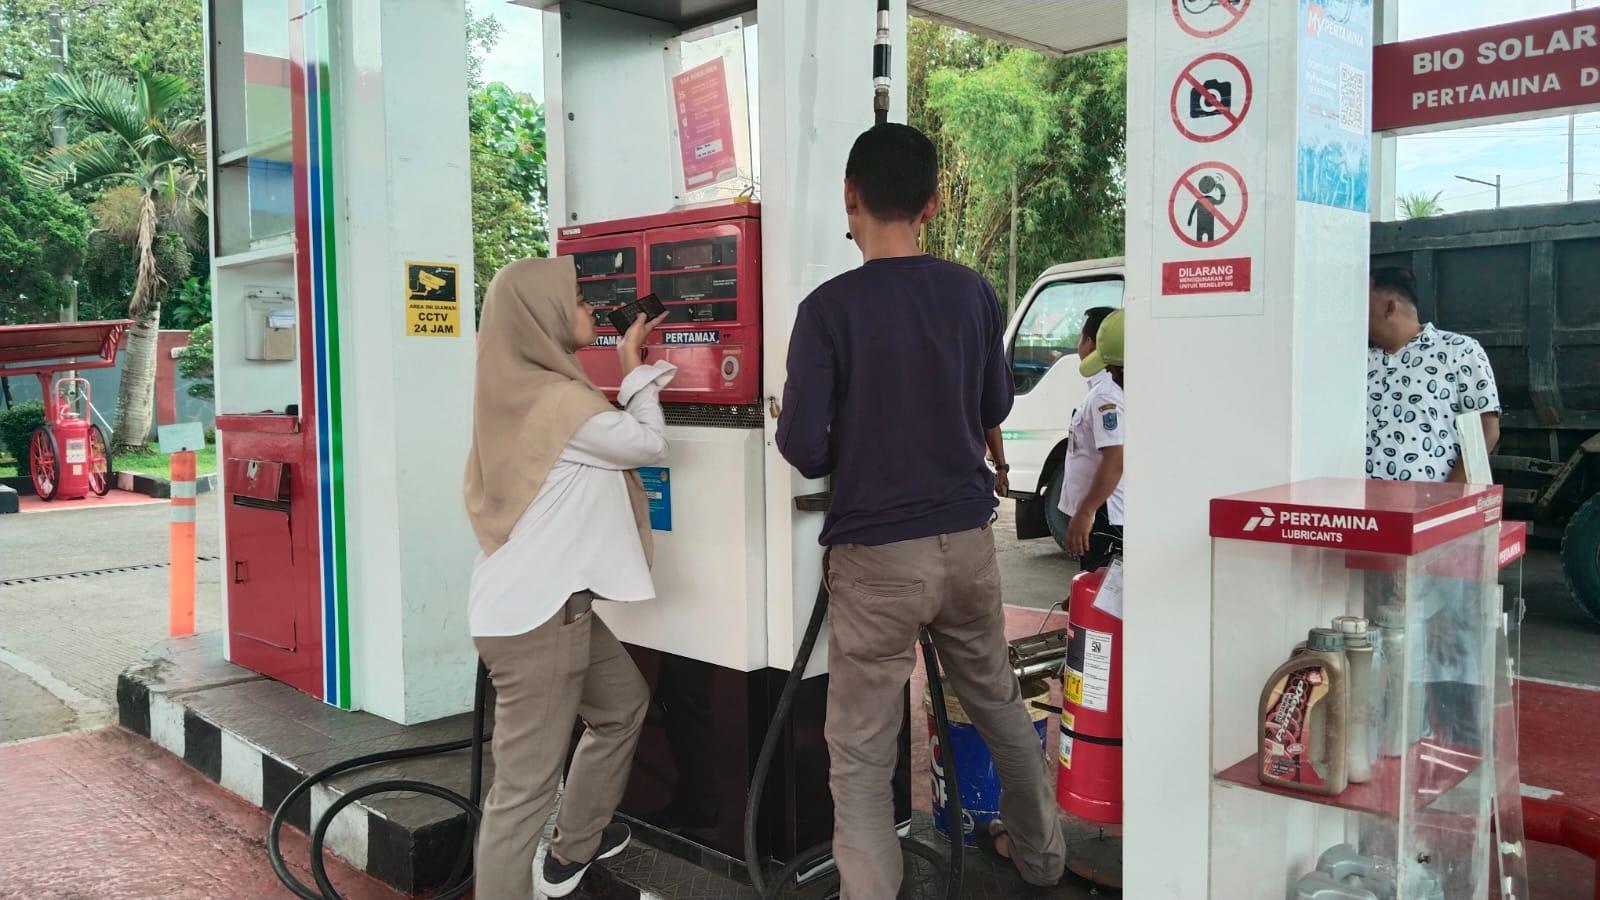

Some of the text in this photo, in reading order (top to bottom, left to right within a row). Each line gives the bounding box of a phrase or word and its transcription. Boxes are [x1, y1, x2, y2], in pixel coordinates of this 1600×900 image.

[1412, 25, 1597, 75] BIO SOLAR
[1412, 73, 1561, 110] PERTAMINA
[1178, 265, 1234, 277] DILARANG
[418, 312, 449, 322] CCTV
[414, 323, 454, 334] 24 JAM
[665, 332, 716, 344] PERTAMAX
[1279, 511, 1379, 531] PERTAMINA
[1281, 528, 1343, 543] LUBRICANTS
